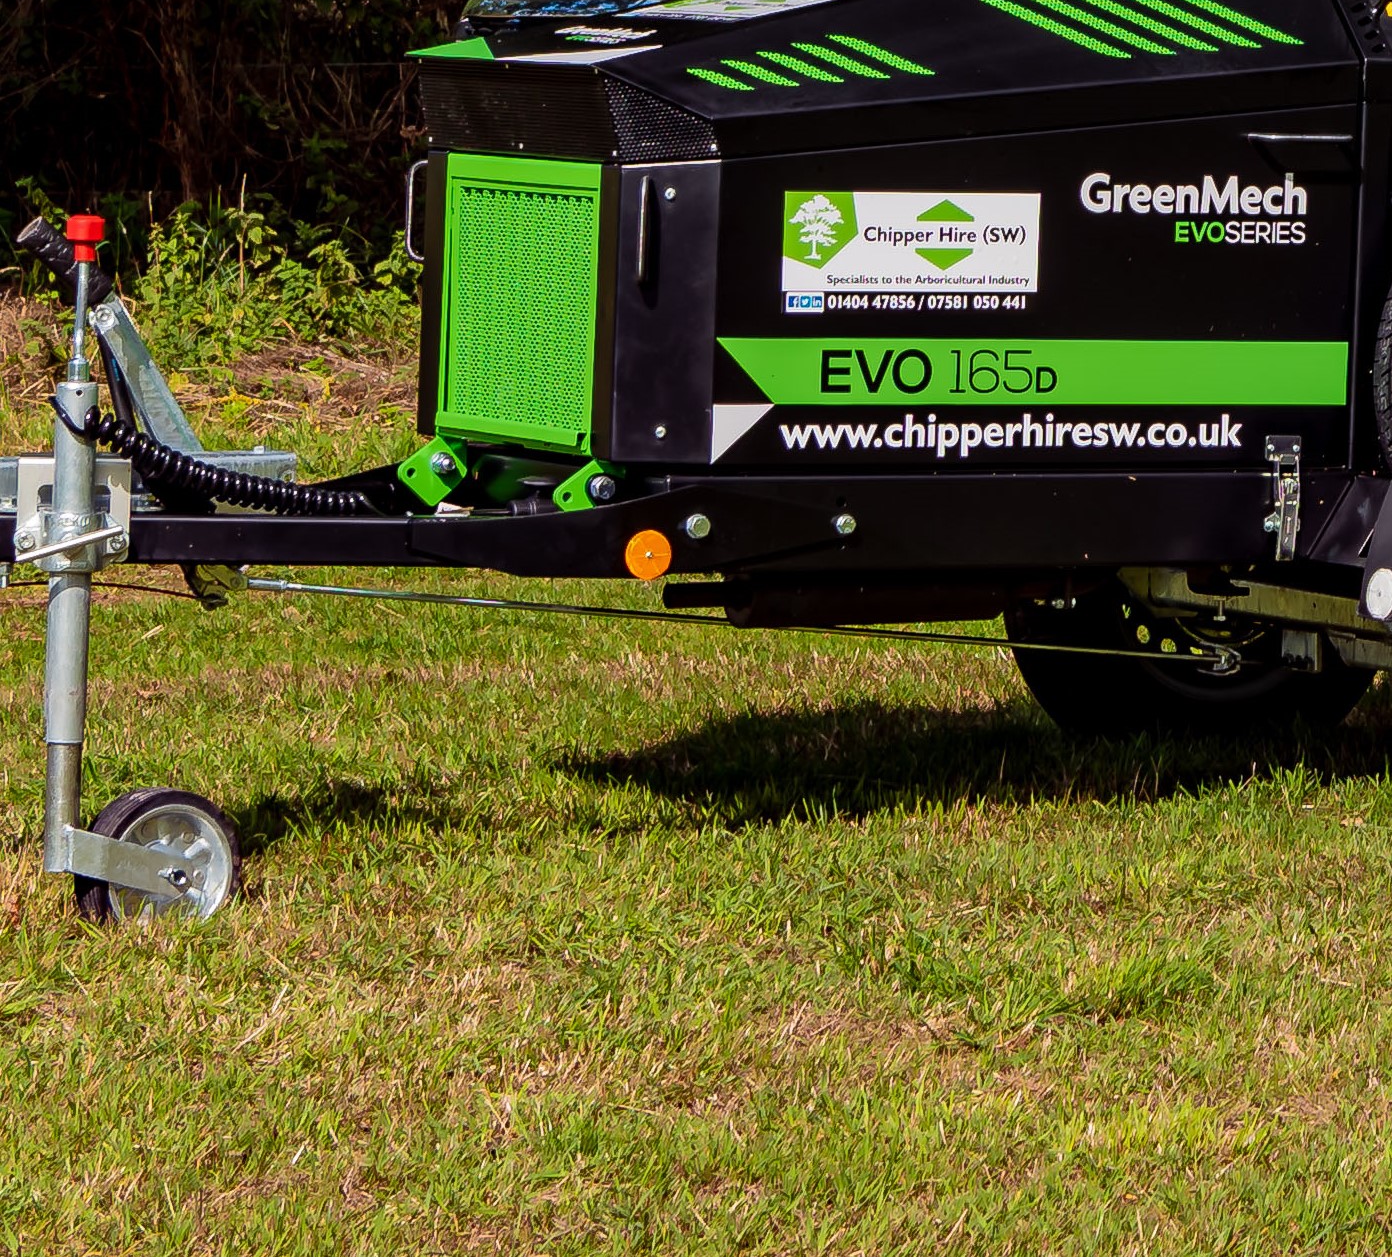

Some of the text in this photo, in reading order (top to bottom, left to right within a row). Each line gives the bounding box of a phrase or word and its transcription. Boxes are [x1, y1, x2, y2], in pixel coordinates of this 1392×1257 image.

[1080, 172, 1308, 215] GreenMech
[863, 225, 1026, 247] Chipper Hire (SW)
[1174, 220, 1306, 245] EVOSERIES
[826, 274, 1030, 287] Specialists to the Arboricultural Industry
[827, 294, 869, 310] 01404
[871, 294, 916, 310] 47856
[927, 294, 968, 310] 07581
[973, 294, 1000, 310] 050
[1001, 294, 1026, 310] 441
[820, 348, 933, 394] EVO
[779, 413, 1243, 458] www.chipperhiresw.co.uk
